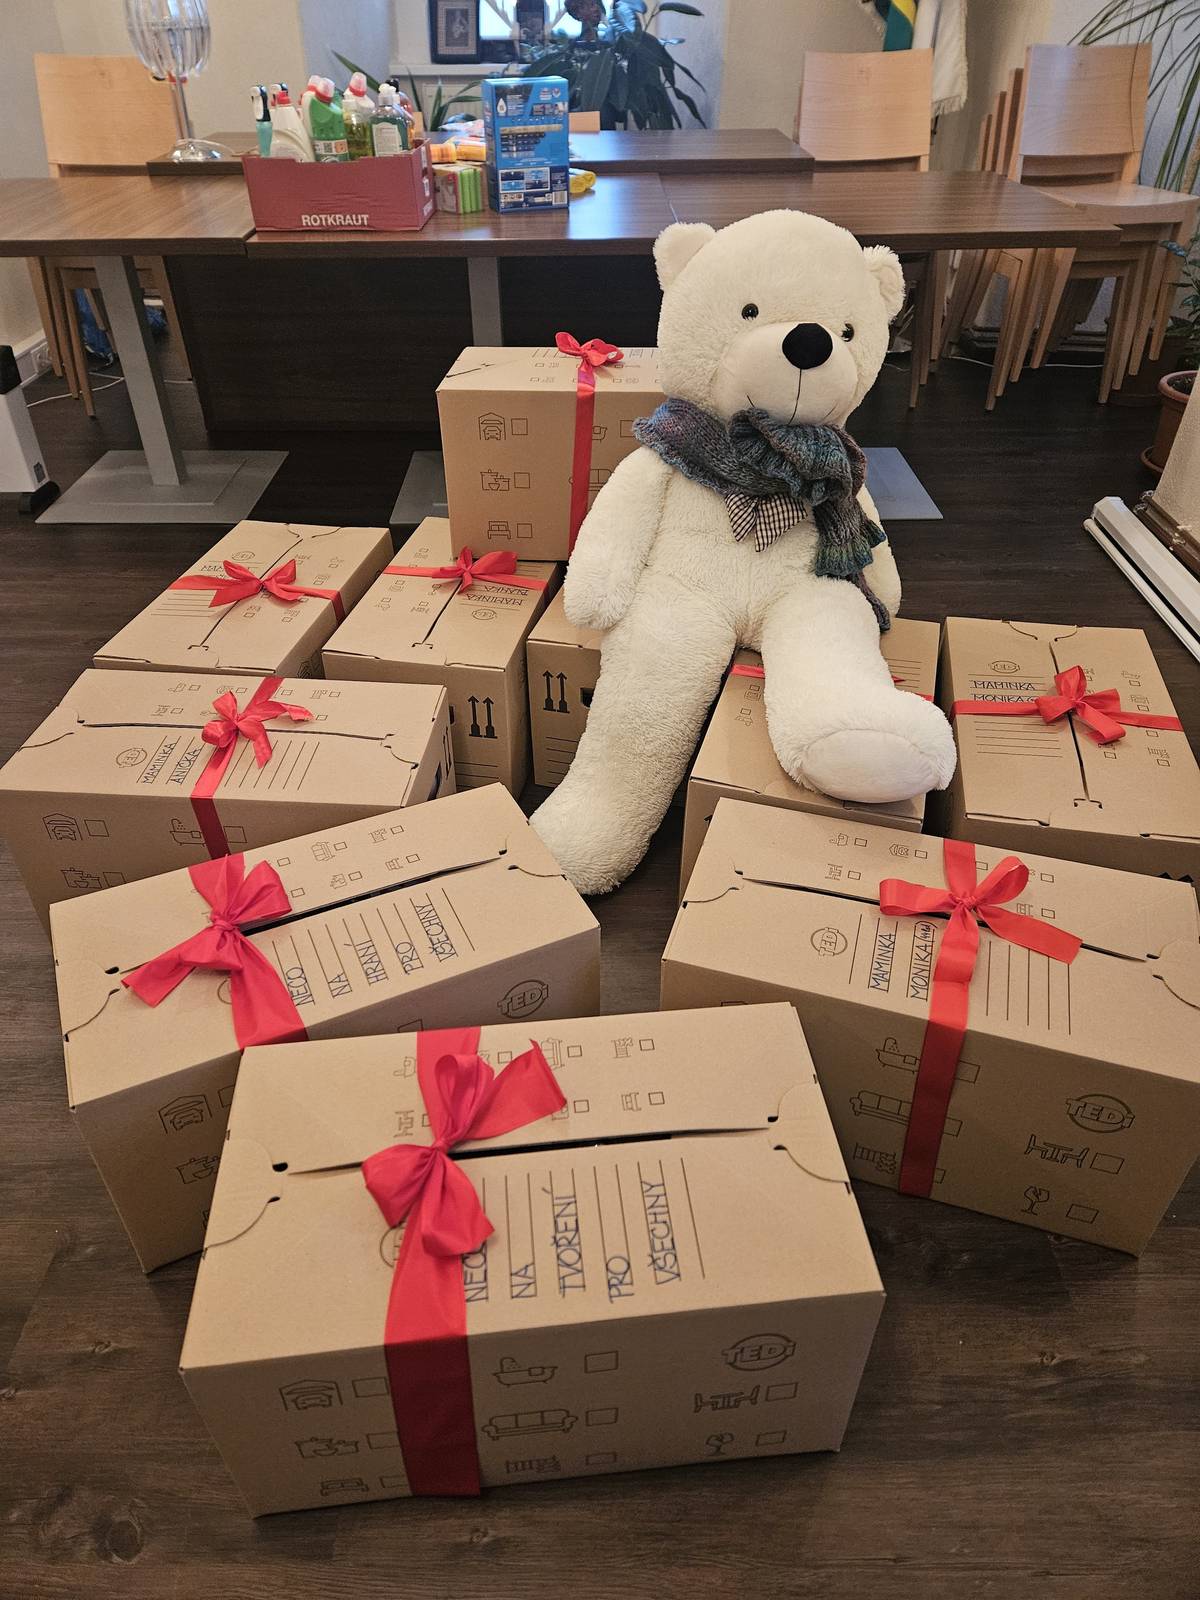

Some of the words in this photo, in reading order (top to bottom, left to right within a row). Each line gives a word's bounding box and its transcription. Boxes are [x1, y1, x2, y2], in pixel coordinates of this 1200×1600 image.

[301, 214, 369, 226] ROTKRAUT
[466, 593, 523, 606] MAMINKA
[973, 680, 1036, 691] MAMINKA
[142, 742, 178, 784] MAMINKA
[415, 903, 459, 963] VŠECHNY
[344, 939, 389, 986] HRANÍ
[395, 941, 424, 976] PRO
[869, 933, 896, 993] MAMINKA
[910, 943, 932, 1001] MONIKA
[328, 972, 352, 999] NA
[542, 1186, 586, 1298] TVOŘENÍ
[640, 1179, 682, 1286] VŠECHNY
[510, 1262, 538, 1299] NA
[605, 1255, 635, 1304] PRO
